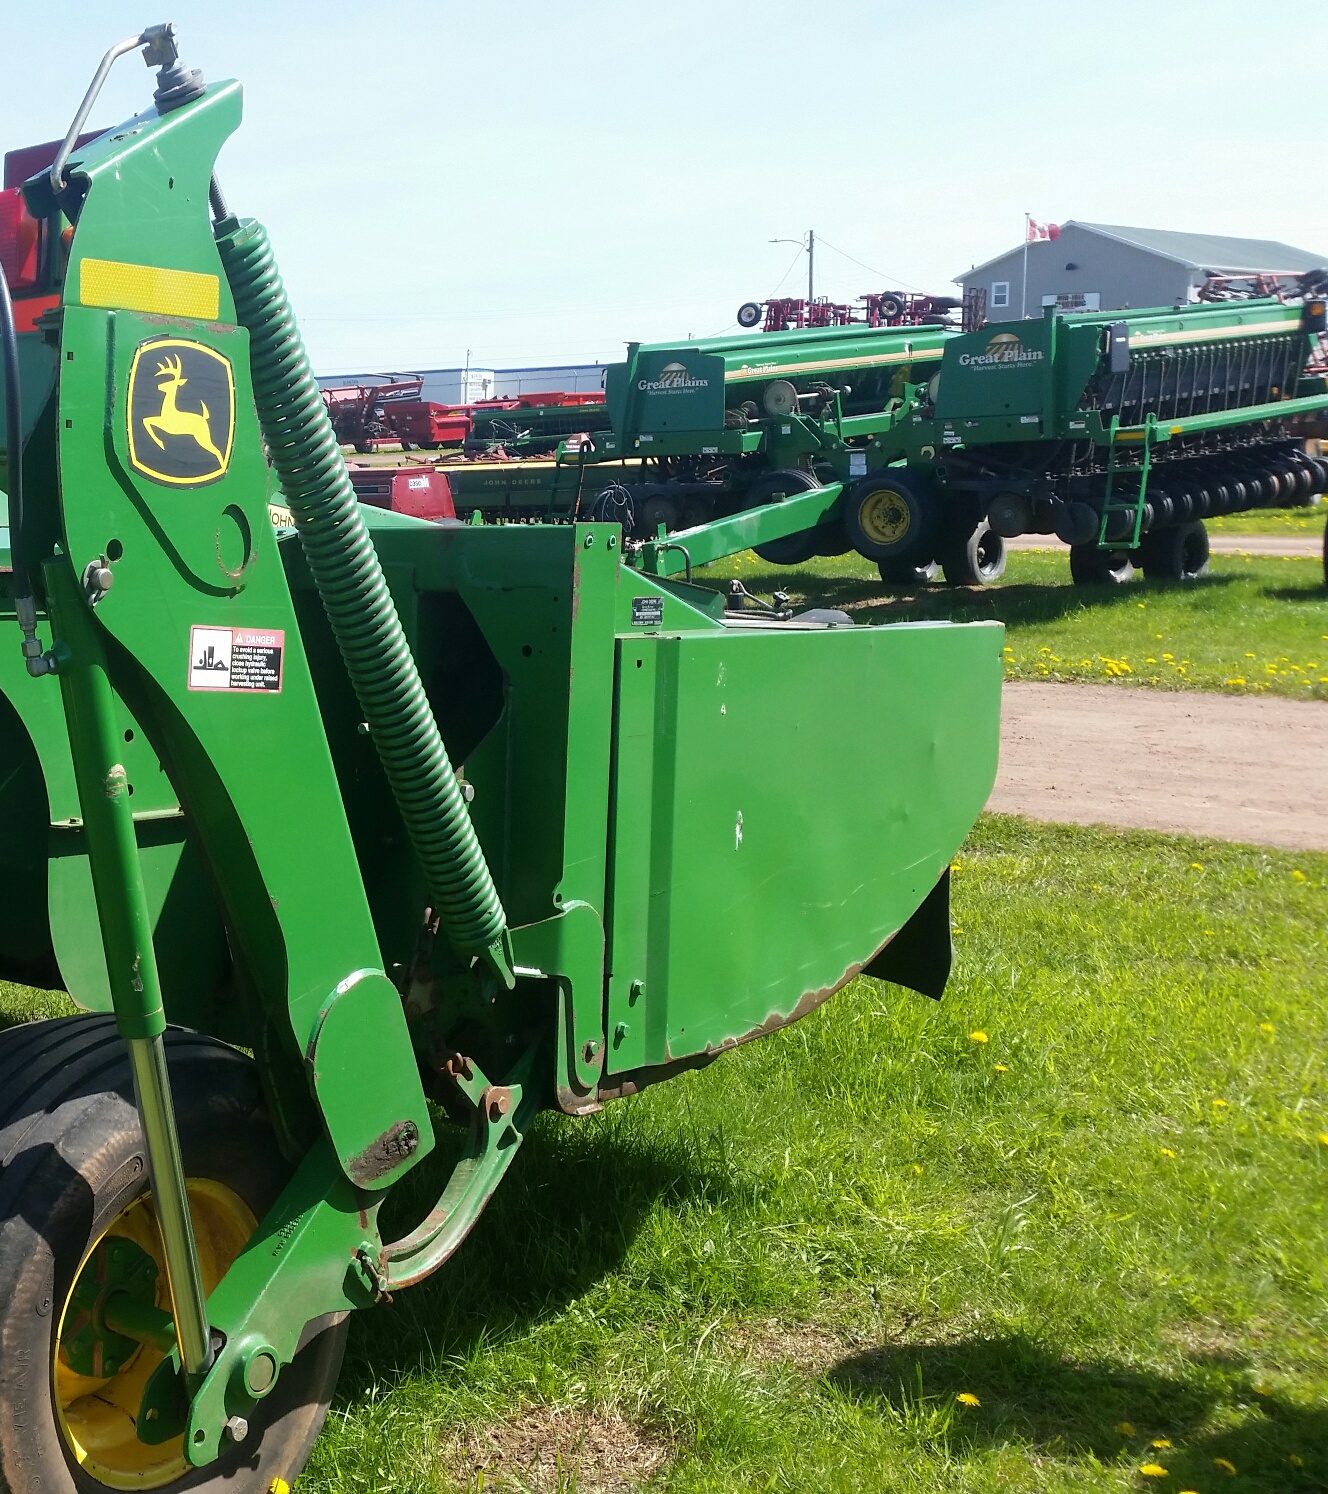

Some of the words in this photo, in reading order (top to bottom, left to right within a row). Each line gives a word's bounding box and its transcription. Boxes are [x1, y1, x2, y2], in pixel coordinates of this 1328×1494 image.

[959, 353, 1001, 365] Great
[637, 379, 672, 390] Great
[673, 377, 709, 388] Plains
[245, 634, 276, 645] DANGER
[245, 660, 267, 668] hydraulic
[260, 667, 275, 675] before
[231, 673, 250, 682] working
[231, 680, 255, 688] harvesting
